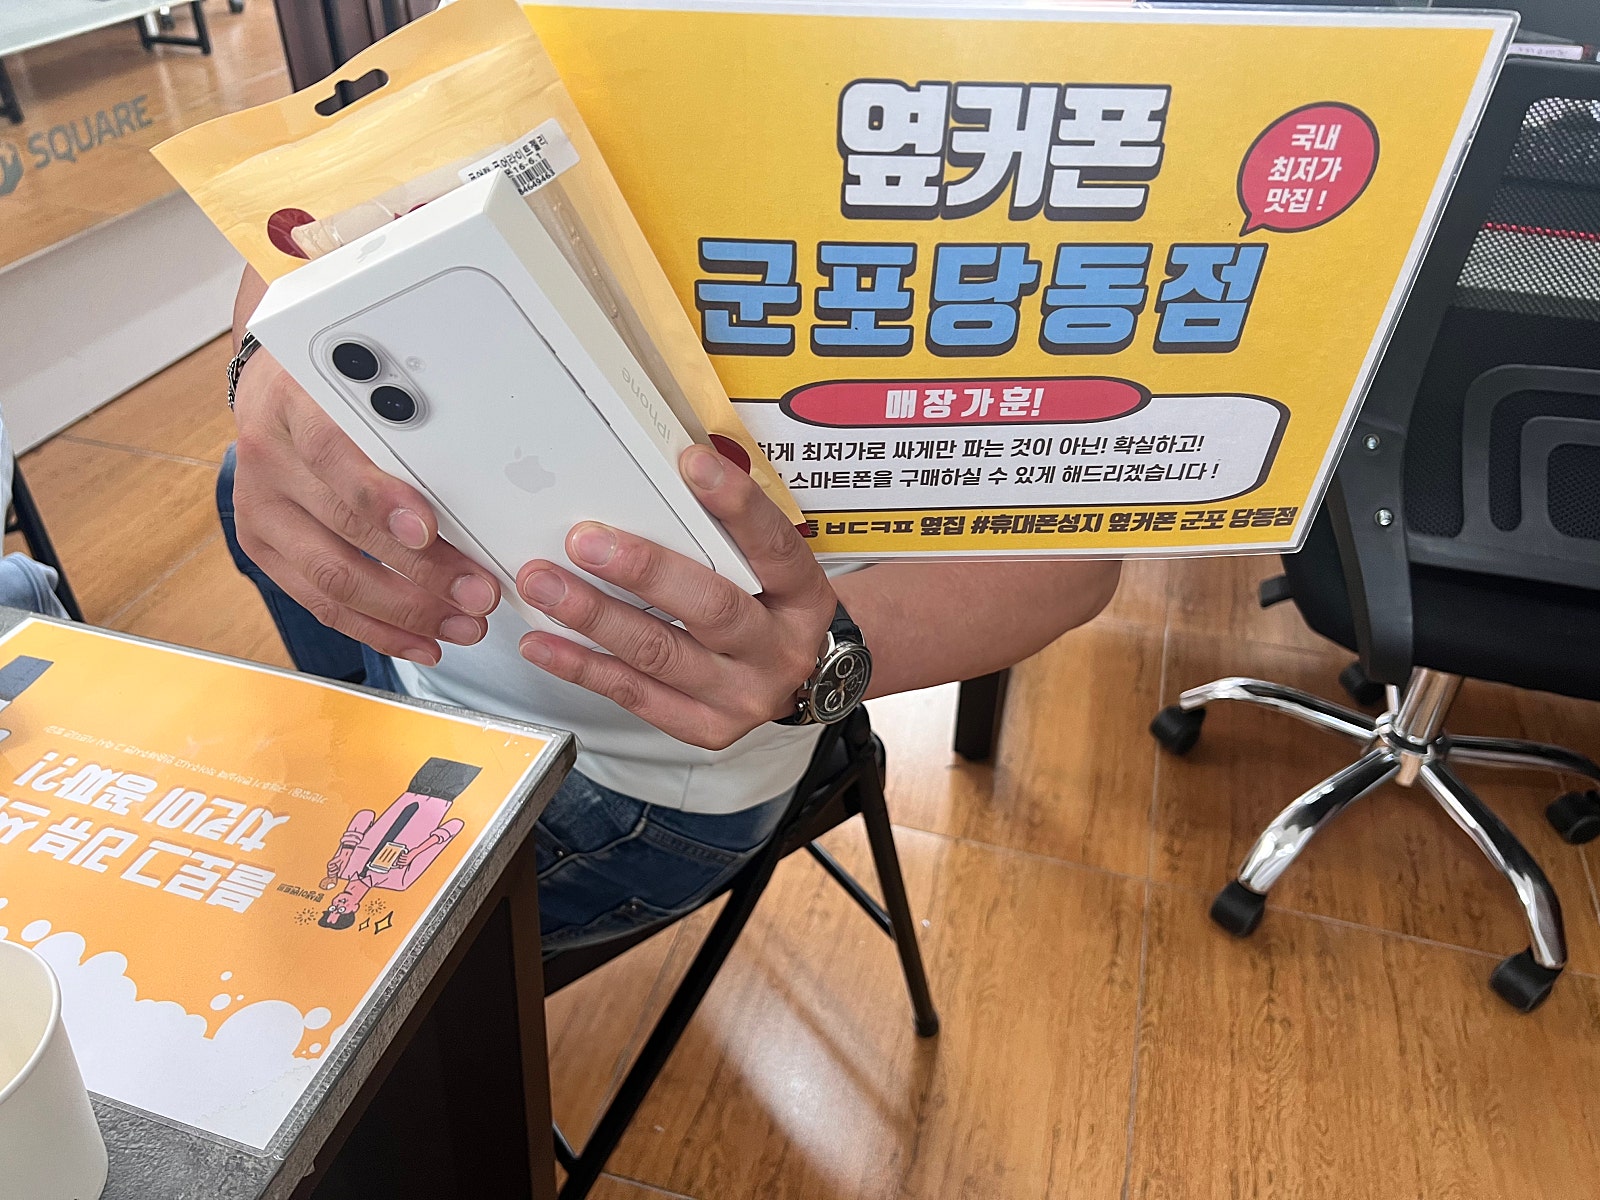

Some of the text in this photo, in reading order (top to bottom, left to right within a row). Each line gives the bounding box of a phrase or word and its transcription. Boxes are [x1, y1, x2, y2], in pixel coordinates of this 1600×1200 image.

[27, 94, 153, 169] SQUARE
[838, 78, 1172, 221] 옆커폰
[1291, 124, 1342, 151] 국내
[1267, 156, 1343, 183] 최저가
[1263, 188, 1314, 213] 맛집
[695, 238, 1269, 357] 군포당동점
[621, 367, 671, 444] iPhone
[801, 441, 887, 461] 최저가로
[892, 440, 957, 460] 싸게만
[962, 439, 1005, 458] 파는
[1010, 437, 1053, 457] 것이
[1059, 436, 1108, 456] 아닌!
[1113, 435, 1206, 455] 확실하고!
[788, 470, 893, 489] 스마트폰을
[900, 467, 982, 487] 구매하실
[988, 467, 1008, 485] 수
[1014, 466, 1057, 484] 있게
[1062, 463, 1208, 483] 해드리겠습니다
[826, 520, 914, 534] ㅂㄷㅋㅍ
[920, 516, 966, 536] 옆집
[971, 513, 1104, 534] #휴대폰성지
[1107, 511, 1178, 533] 옆커폰
[1179, 509, 1229, 531] 군포
[1228, 506, 1299, 528] 당동점
[13, 751, 291, 852] 치킨이 꽁짜?!
[0, 796, 277, 913] 블로그 리뷰 쓰
